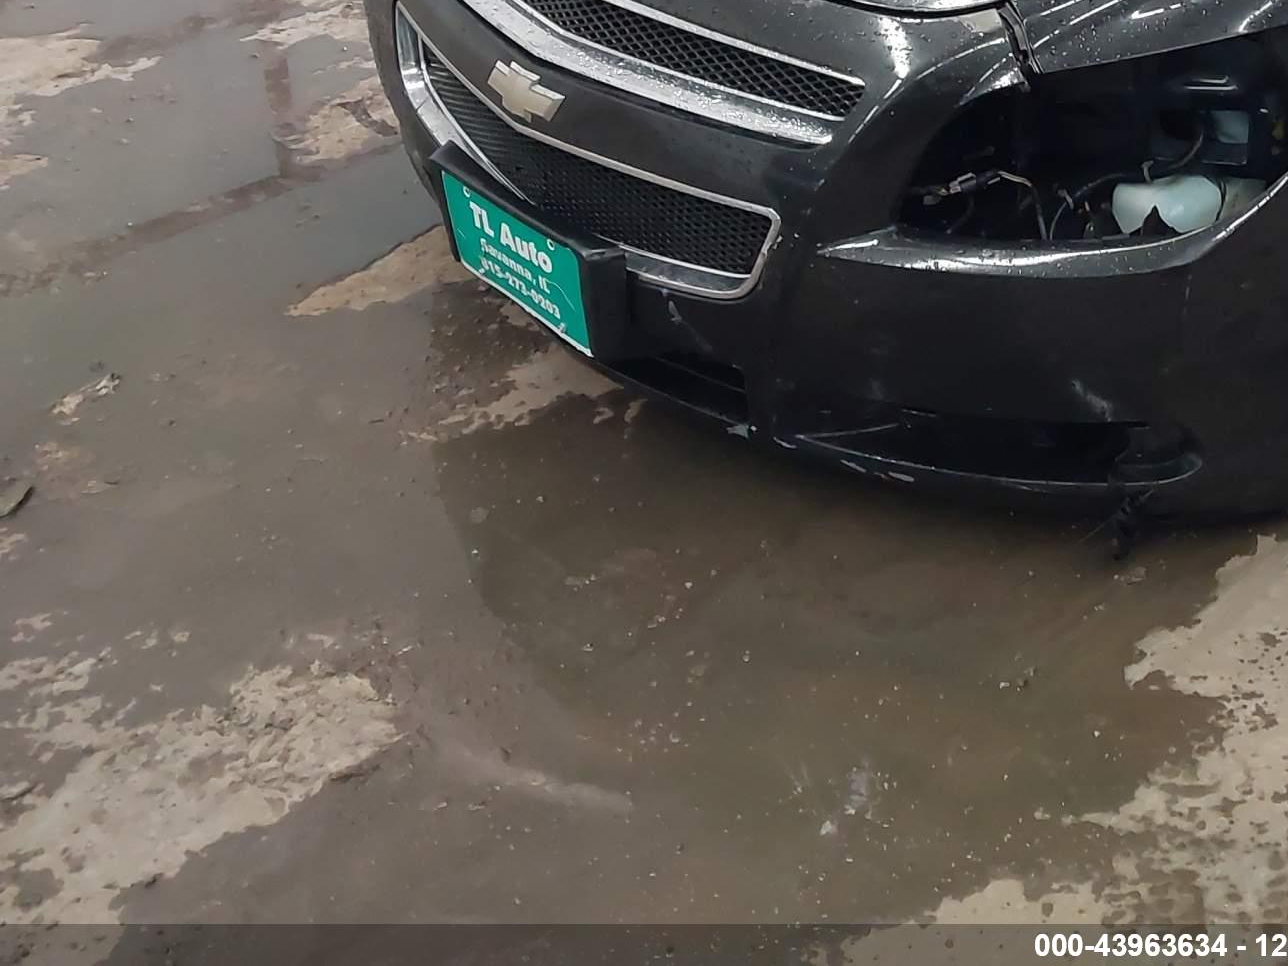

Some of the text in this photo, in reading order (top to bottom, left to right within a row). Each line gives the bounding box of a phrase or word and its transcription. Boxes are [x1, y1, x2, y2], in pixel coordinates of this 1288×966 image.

[469, 201, 553, 273] TL Auto
[480, 238, 536, 285] Savanna,
